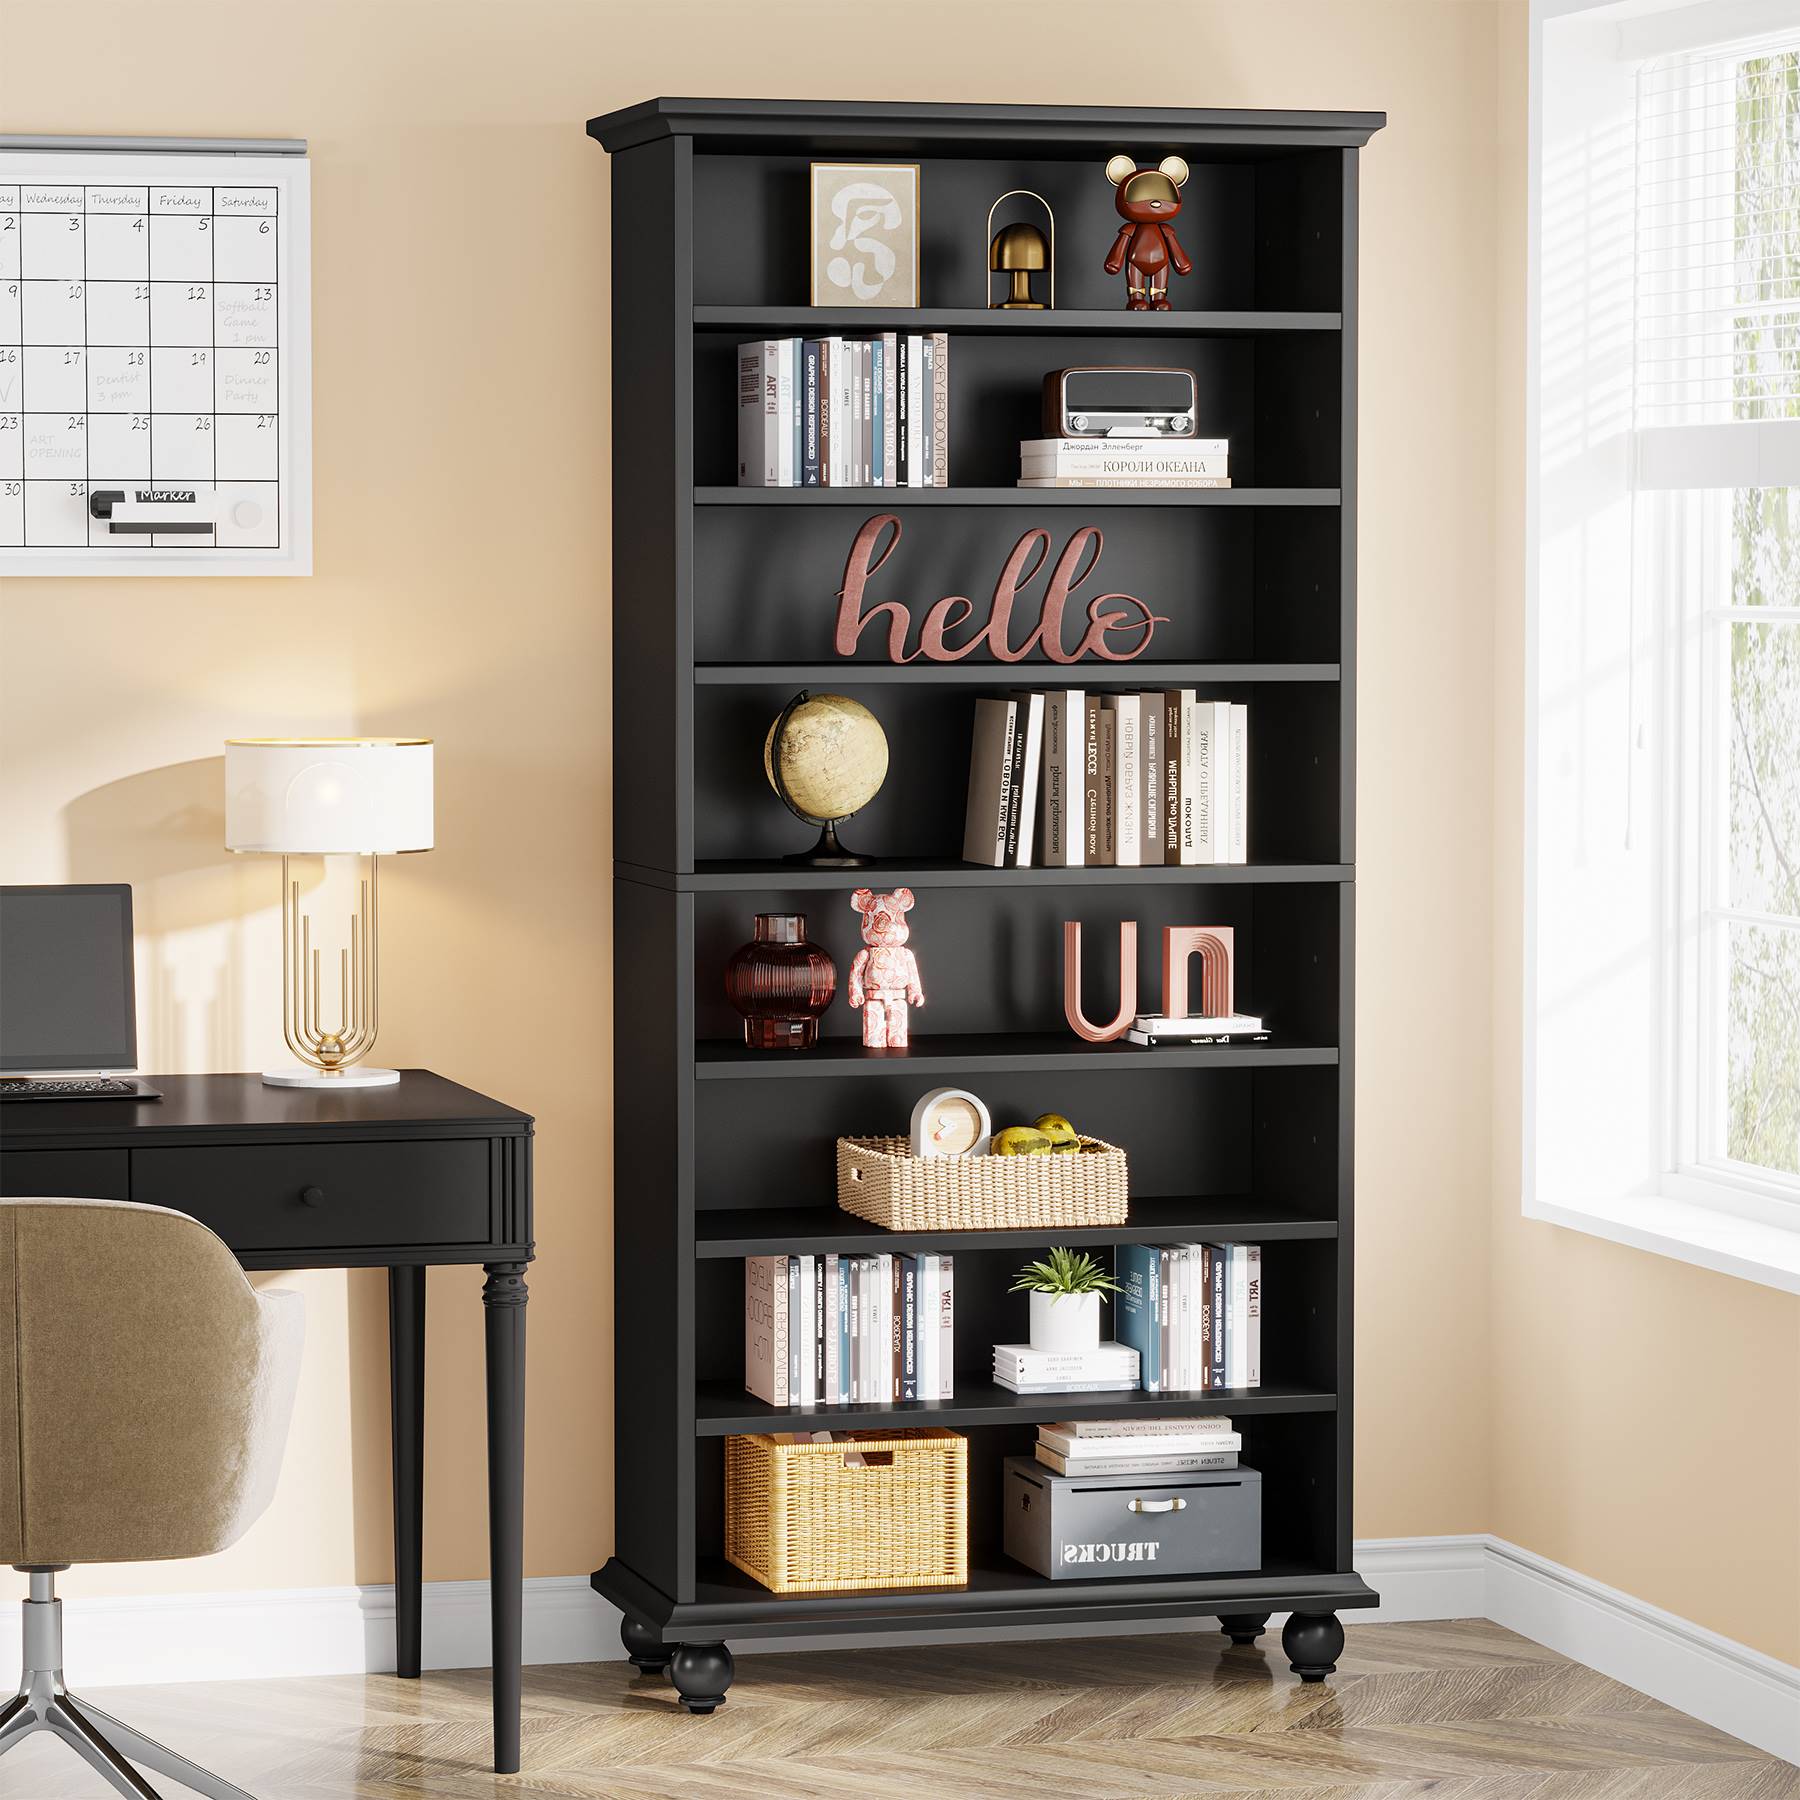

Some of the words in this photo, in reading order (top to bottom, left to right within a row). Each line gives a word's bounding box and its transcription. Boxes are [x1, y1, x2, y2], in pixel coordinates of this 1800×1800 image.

[25, 193, 83, 207] Wednesday
[92, 194, 141, 207] Thursday
[159, 195, 201, 208] Friday
[221, 197, 268, 209] Saturday
[4, 217, 16, 230] 2
[69, 218, 80, 231] 3
[132, 219, 144, 232] 4
[198, 218, 208, 231] 5
[258, 221, 270, 234] 6
[8, 285, 17, 298] 9
[68, 286, 82, 299] 10
[135, 287, 150, 300] 11
[187, 287, 205, 300] 12
[254, 288, 272, 301] 13
[218, 300, 268, 313] Softball
[0, 350, 16, 363] 16
[64, 352, 80, 364] 17
[128, 352, 144, 365] 18
[191, 352, 206, 365] 19
[254, 351, 271, 364] 20
[935, 337, 946, 388] ALEXEY
[767, 375, 777, 398] ART
[885, 369, 894, 401] BOOK
[0, 416, 18, 429] 23
[68, 416, 85, 430] 24
[131, 417, 150, 430] 25
[195, 417, 211, 431] 26
[257, 416, 274, 429] 27
[885, 412, 894, 466] SYMBOLS
[935, 392, 946, 478] BRODOVITCH
[1062, 442, 1099, 451] Джордан
[1102, 442, 1144, 451] Элленберг
[1103, 461, 1152, 472] КОРОЛИ
[1156, 461, 1206, 472] ОКЕАНА
[4, 483, 21, 496] 30
[69, 483, 86, 496] 31
[140, 490, 194, 501] Marker
[834, 513, 1171, 663] hello
